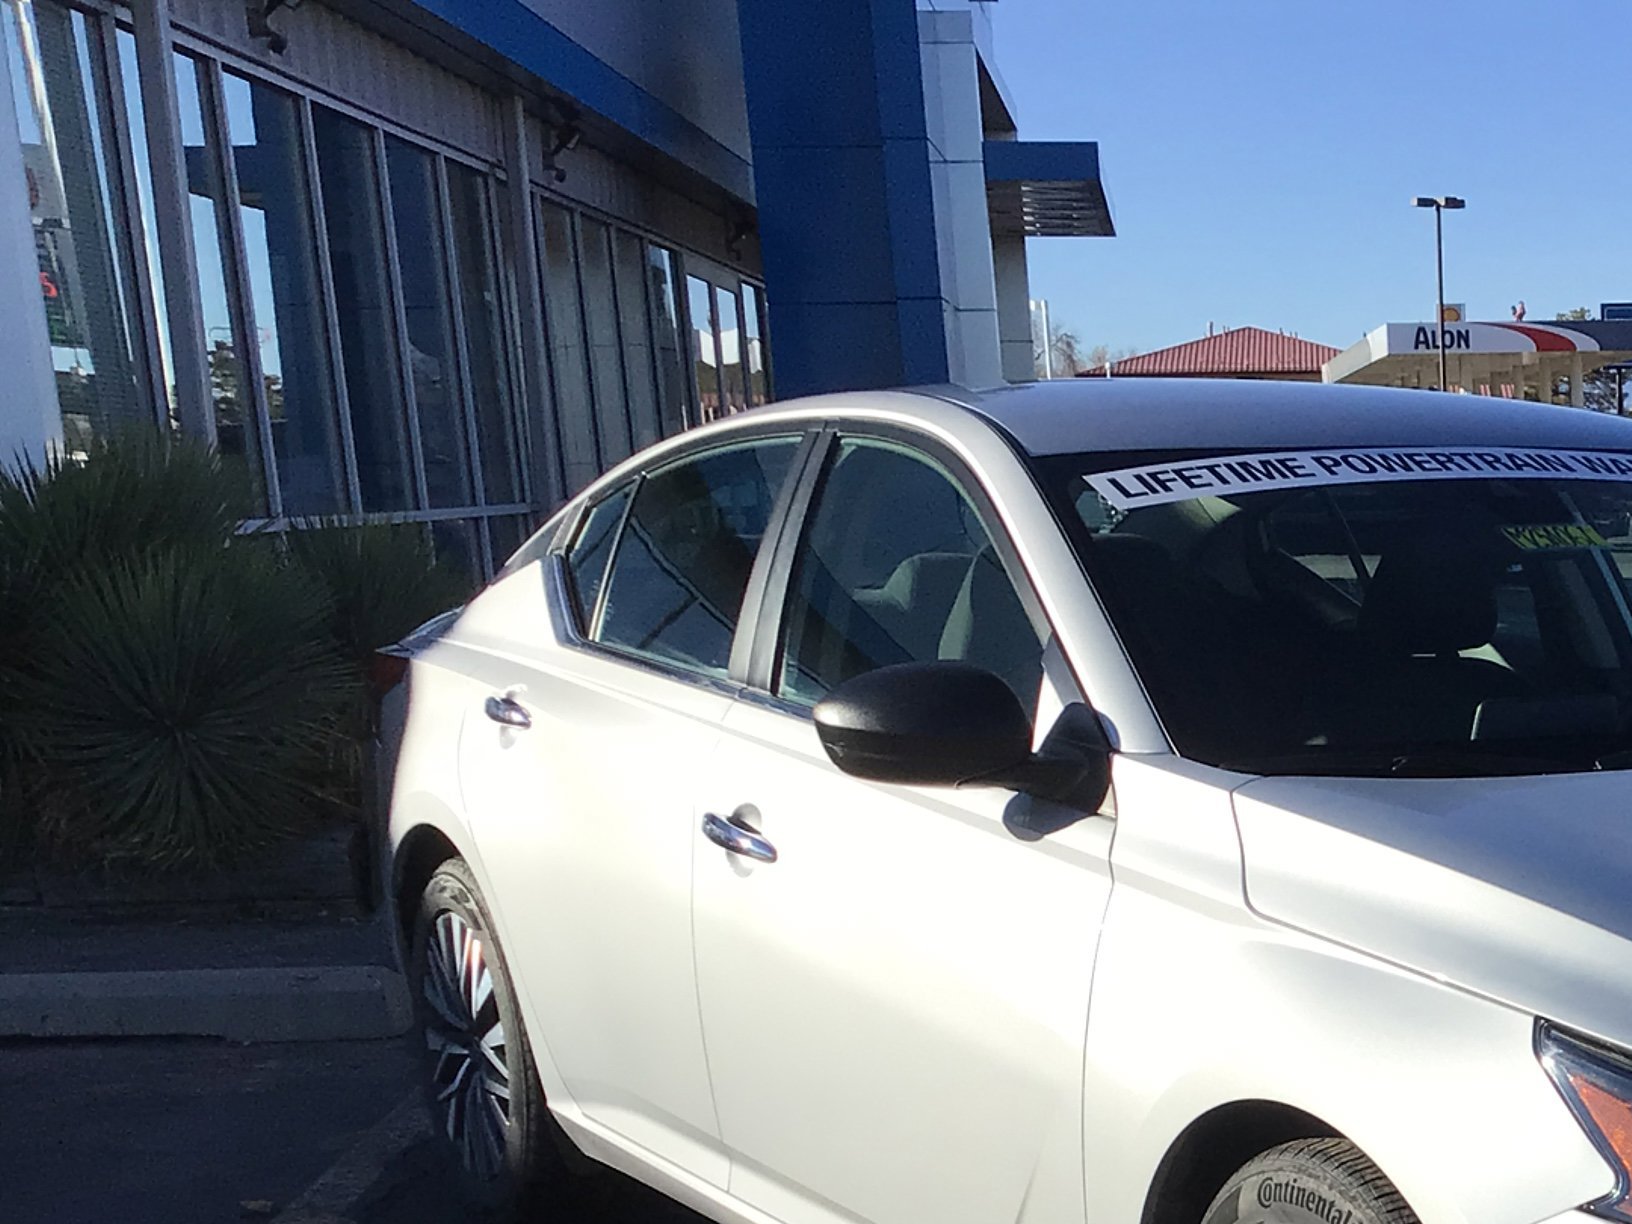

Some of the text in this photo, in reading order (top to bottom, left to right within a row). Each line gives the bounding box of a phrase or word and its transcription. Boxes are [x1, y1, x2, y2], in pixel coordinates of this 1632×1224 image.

[1414, 326, 1470, 350] ALON
[1106, 457, 1316, 499] LIFETIME
[1310, 451, 1578, 477] POWERTRAIN
